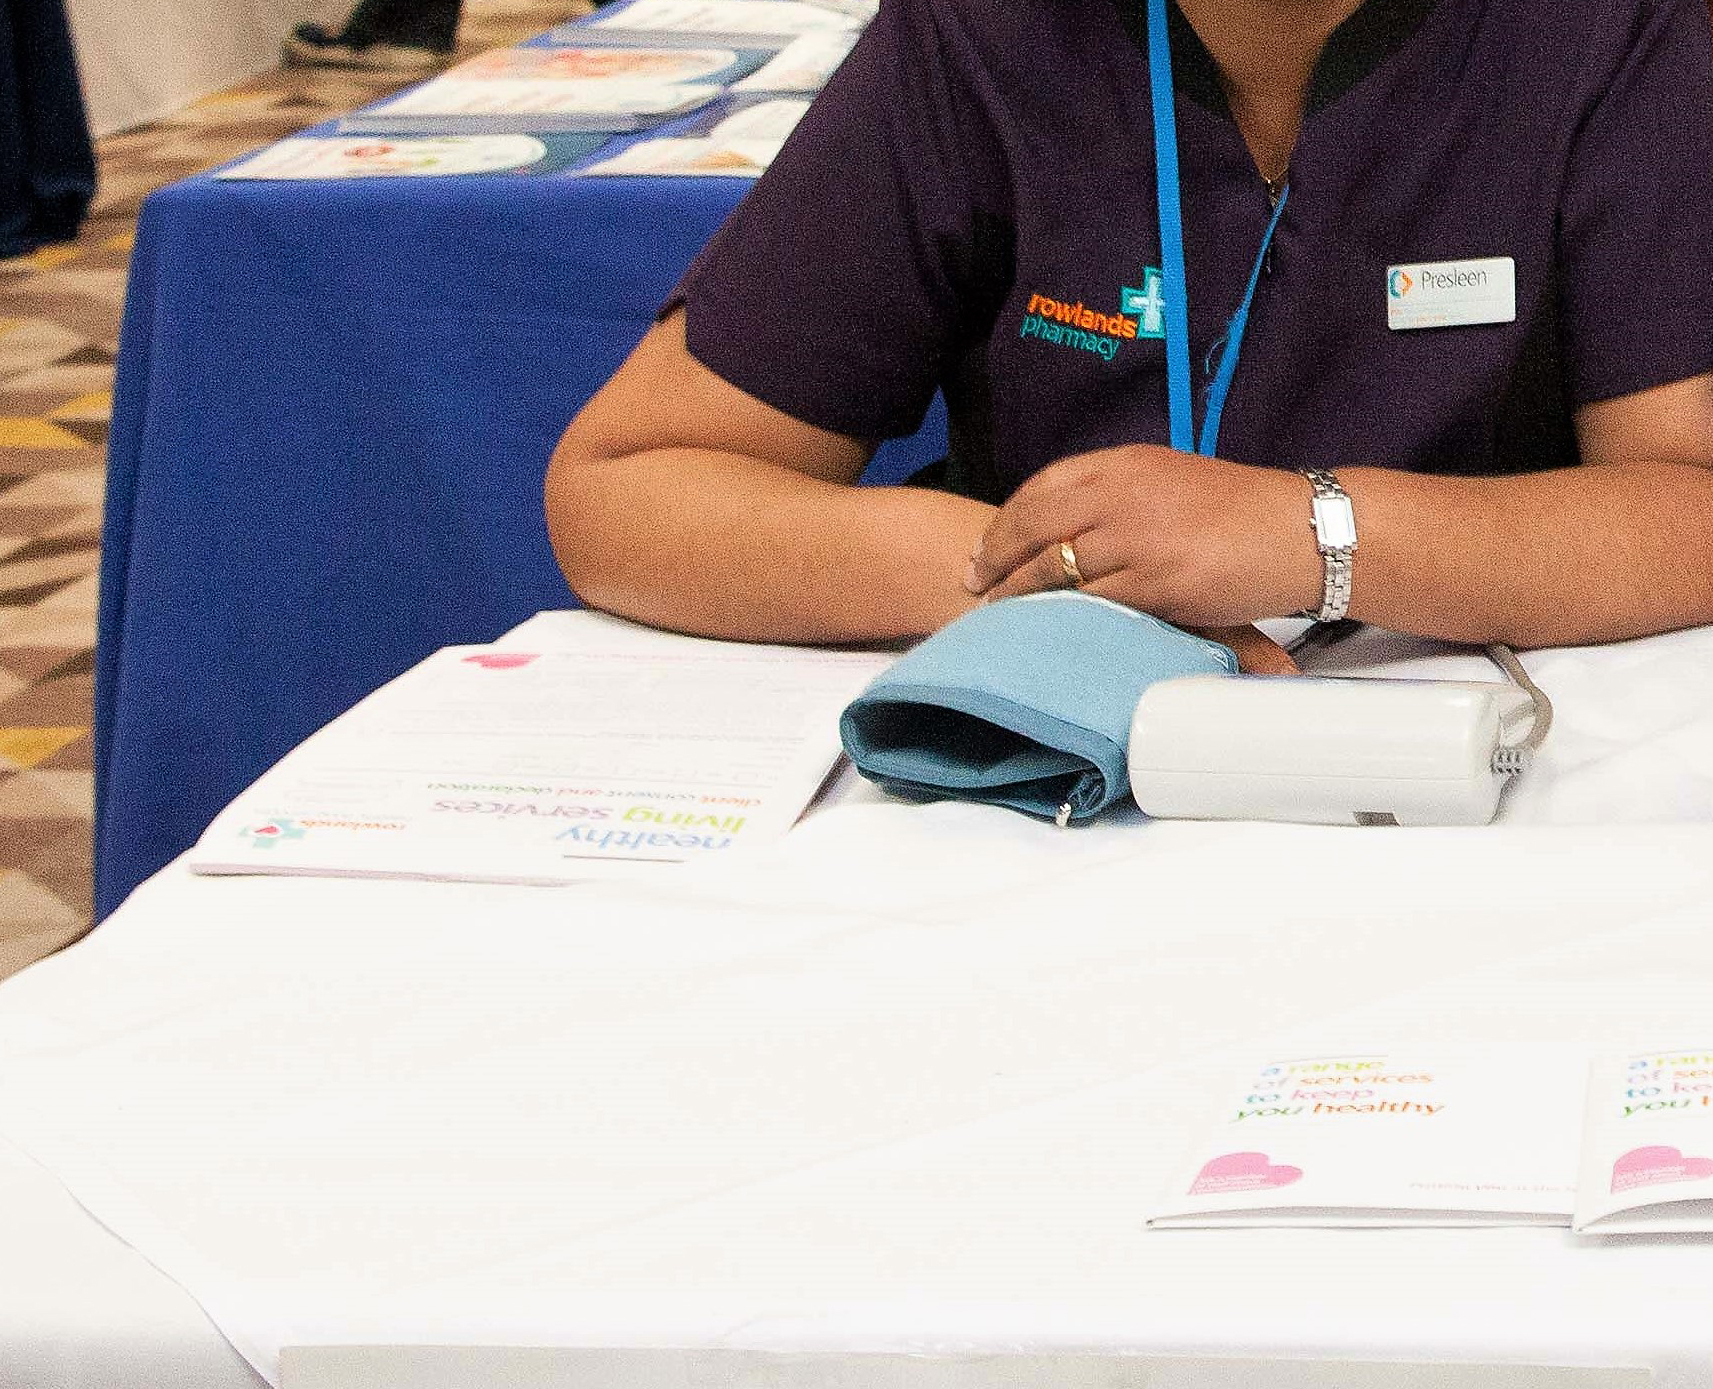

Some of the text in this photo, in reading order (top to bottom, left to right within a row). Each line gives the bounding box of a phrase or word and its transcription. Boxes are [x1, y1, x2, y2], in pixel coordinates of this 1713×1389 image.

[1419, 266, 1488, 291] Presleen
[1026, 292, 1138, 340] rowlands
[1019, 312, 1121, 361] pharmacy
[426, 782, 553, 797] declaration
[555, 787, 604, 799] and
[700, 794, 762, 809] client
[427, 800, 748, 836] living services
[299, 819, 407, 835] rowlands
[554, 824, 733, 851] healthy
[1260, 1061, 1386, 1077] a range
[1627, 1059, 1649, 1070] a
[1252, 1073, 1435, 1090] of services
[1626, 1069, 1664, 1085] of
[1245, 1088, 1376, 1105] to keep
[1626, 1085, 1662, 1099] to
[1227, 1100, 1446, 1125] you healthy
[1616, 1096, 1693, 1119] you
